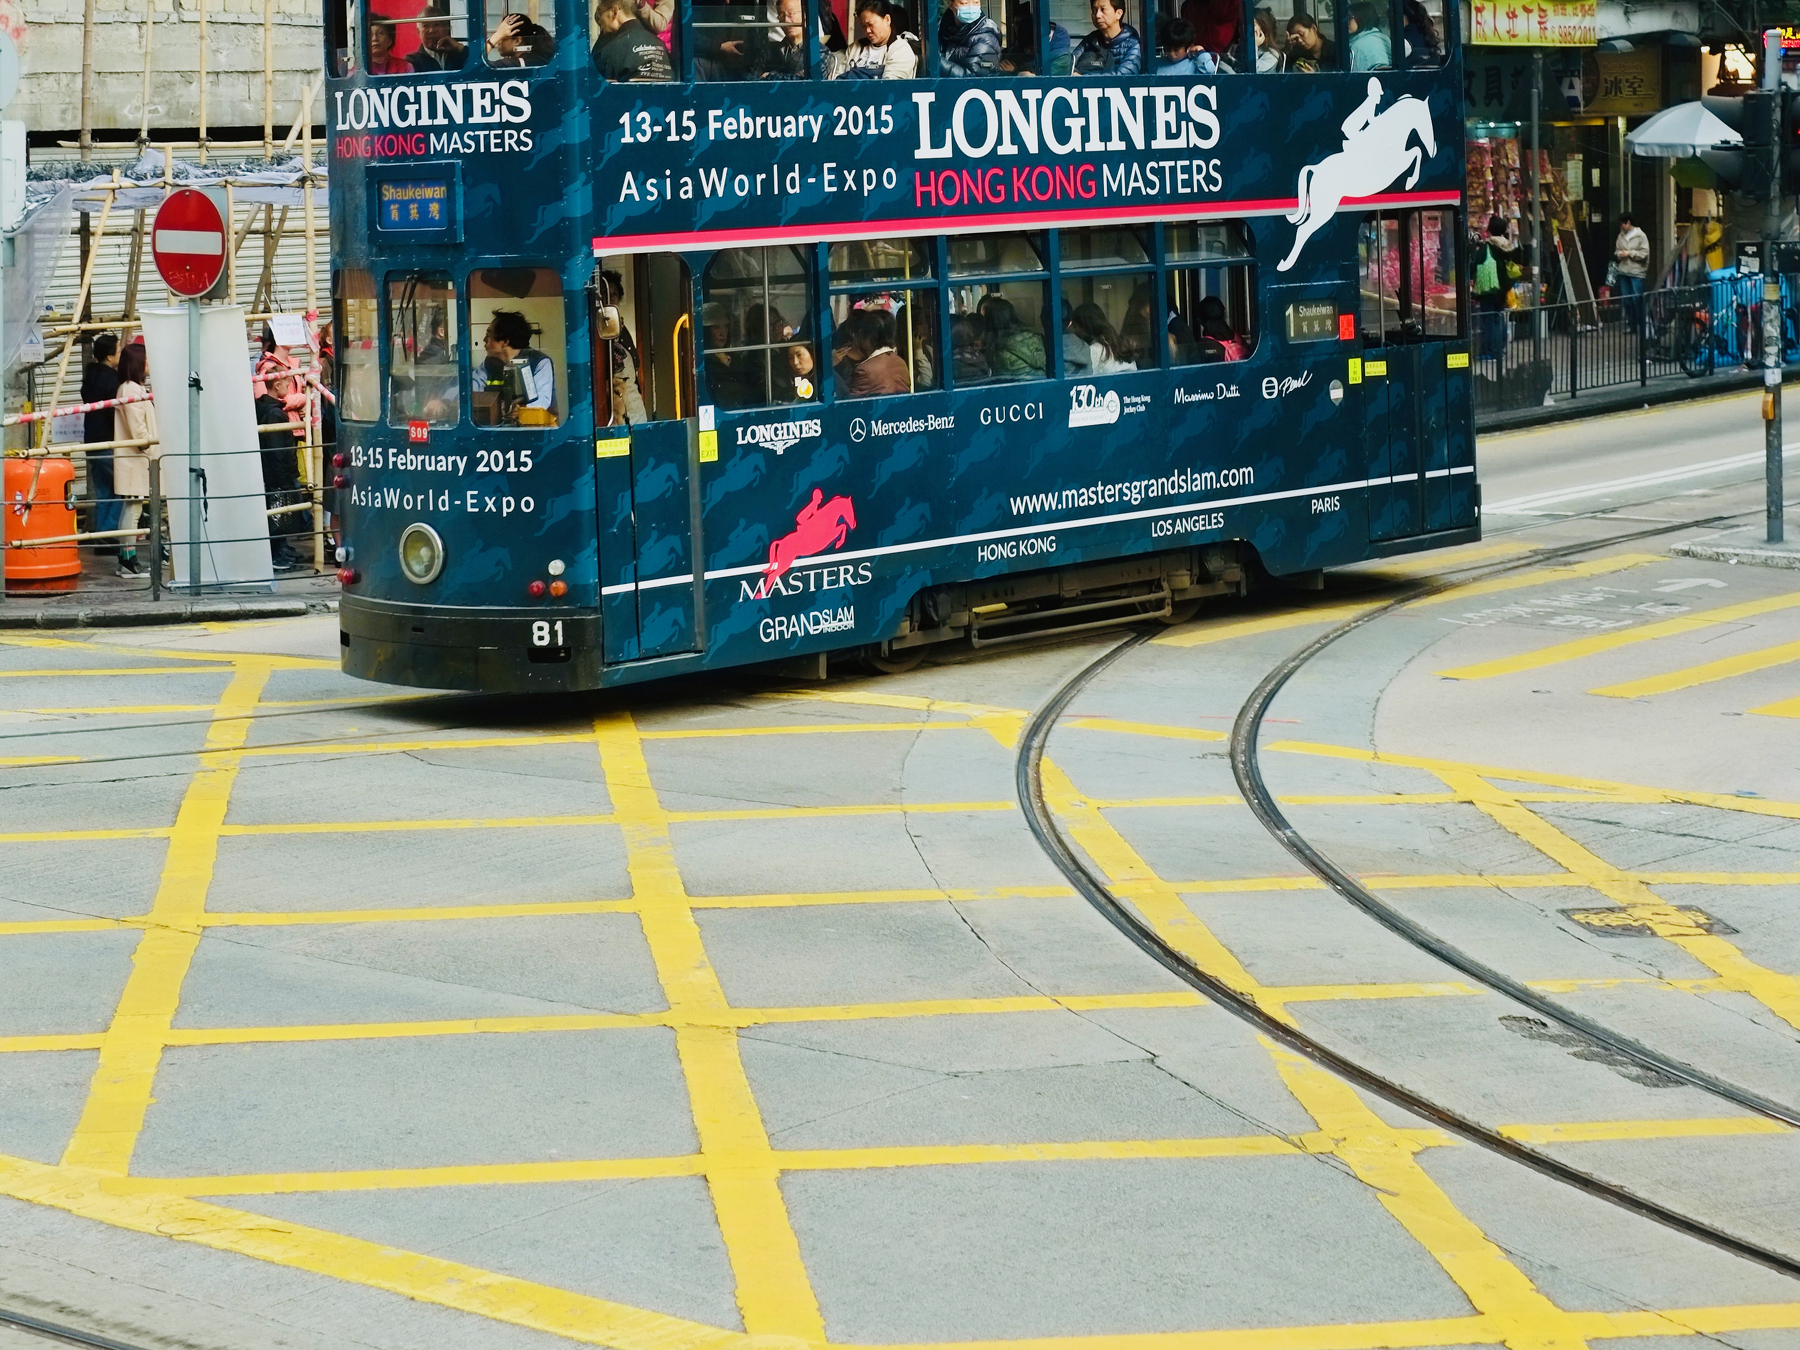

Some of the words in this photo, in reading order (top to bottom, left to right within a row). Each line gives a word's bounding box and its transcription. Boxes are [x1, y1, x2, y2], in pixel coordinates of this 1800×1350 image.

[1603, 75, 1652, 98] 冰室
[335, 80, 532, 131] LONGINES
[618, 110, 697, 144] 13-15
[708, 108, 824, 143] February
[833, 105, 894, 136] 2015
[911, 84, 1220, 159] LONGINES
[336, 136, 372, 159] HONG
[374, 133, 425, 156] KONG
[429, 129, 533, 154] MASTERS
[382, 183, 446, 201] Shaukeiwan
[619, 162, 897, 202] AsiaWorld-Expo
[914, 166, 1006, 207] HONG
[1011, 163, 1097, 202] KONG
[1102, 158, 1222, 197] MASTERS
[389, 202, 440, 222] 筲箕灣
[1285, 304, 1295, 338] 1
[1299, 304, 1334, 318] Shaukeiwan
[1174, 387, 1215, 404] Massimo
[1216, 382, 1241, 400] Dutti
[980, 402, 1044, 425] GUCCI
[1136, 404, 1146, 412] Club
[411, 428, 428, 439] S09
[736, 419, 822, 445] LONGINES
[870, 414, 955, 437] Mercedes-Benz
[350, 446, 383, 469] 13-15
[389, 448, 468, 477] February
[476, 450, 533, 472] 2015
[701, 449, 716, 458] EXIT
[351, 484, 535, 517] AsiaWorld-Expo
[1010, 466, 1255, 516] www.mastersgrandslam.com
[1311, 496, 1340, 514] PARIS
[1151, 518, 1172, 538] LOS
[1173, 513, 1224, 534] ANGELES
[977, 540, 1018, 563] HONG
[1019, 535, 1057, 556] KONG
[738, 562, 873, 603] MASTERS
[531, 620, 564, 647] 81
[823, 623, 855, 634] INDOOR
